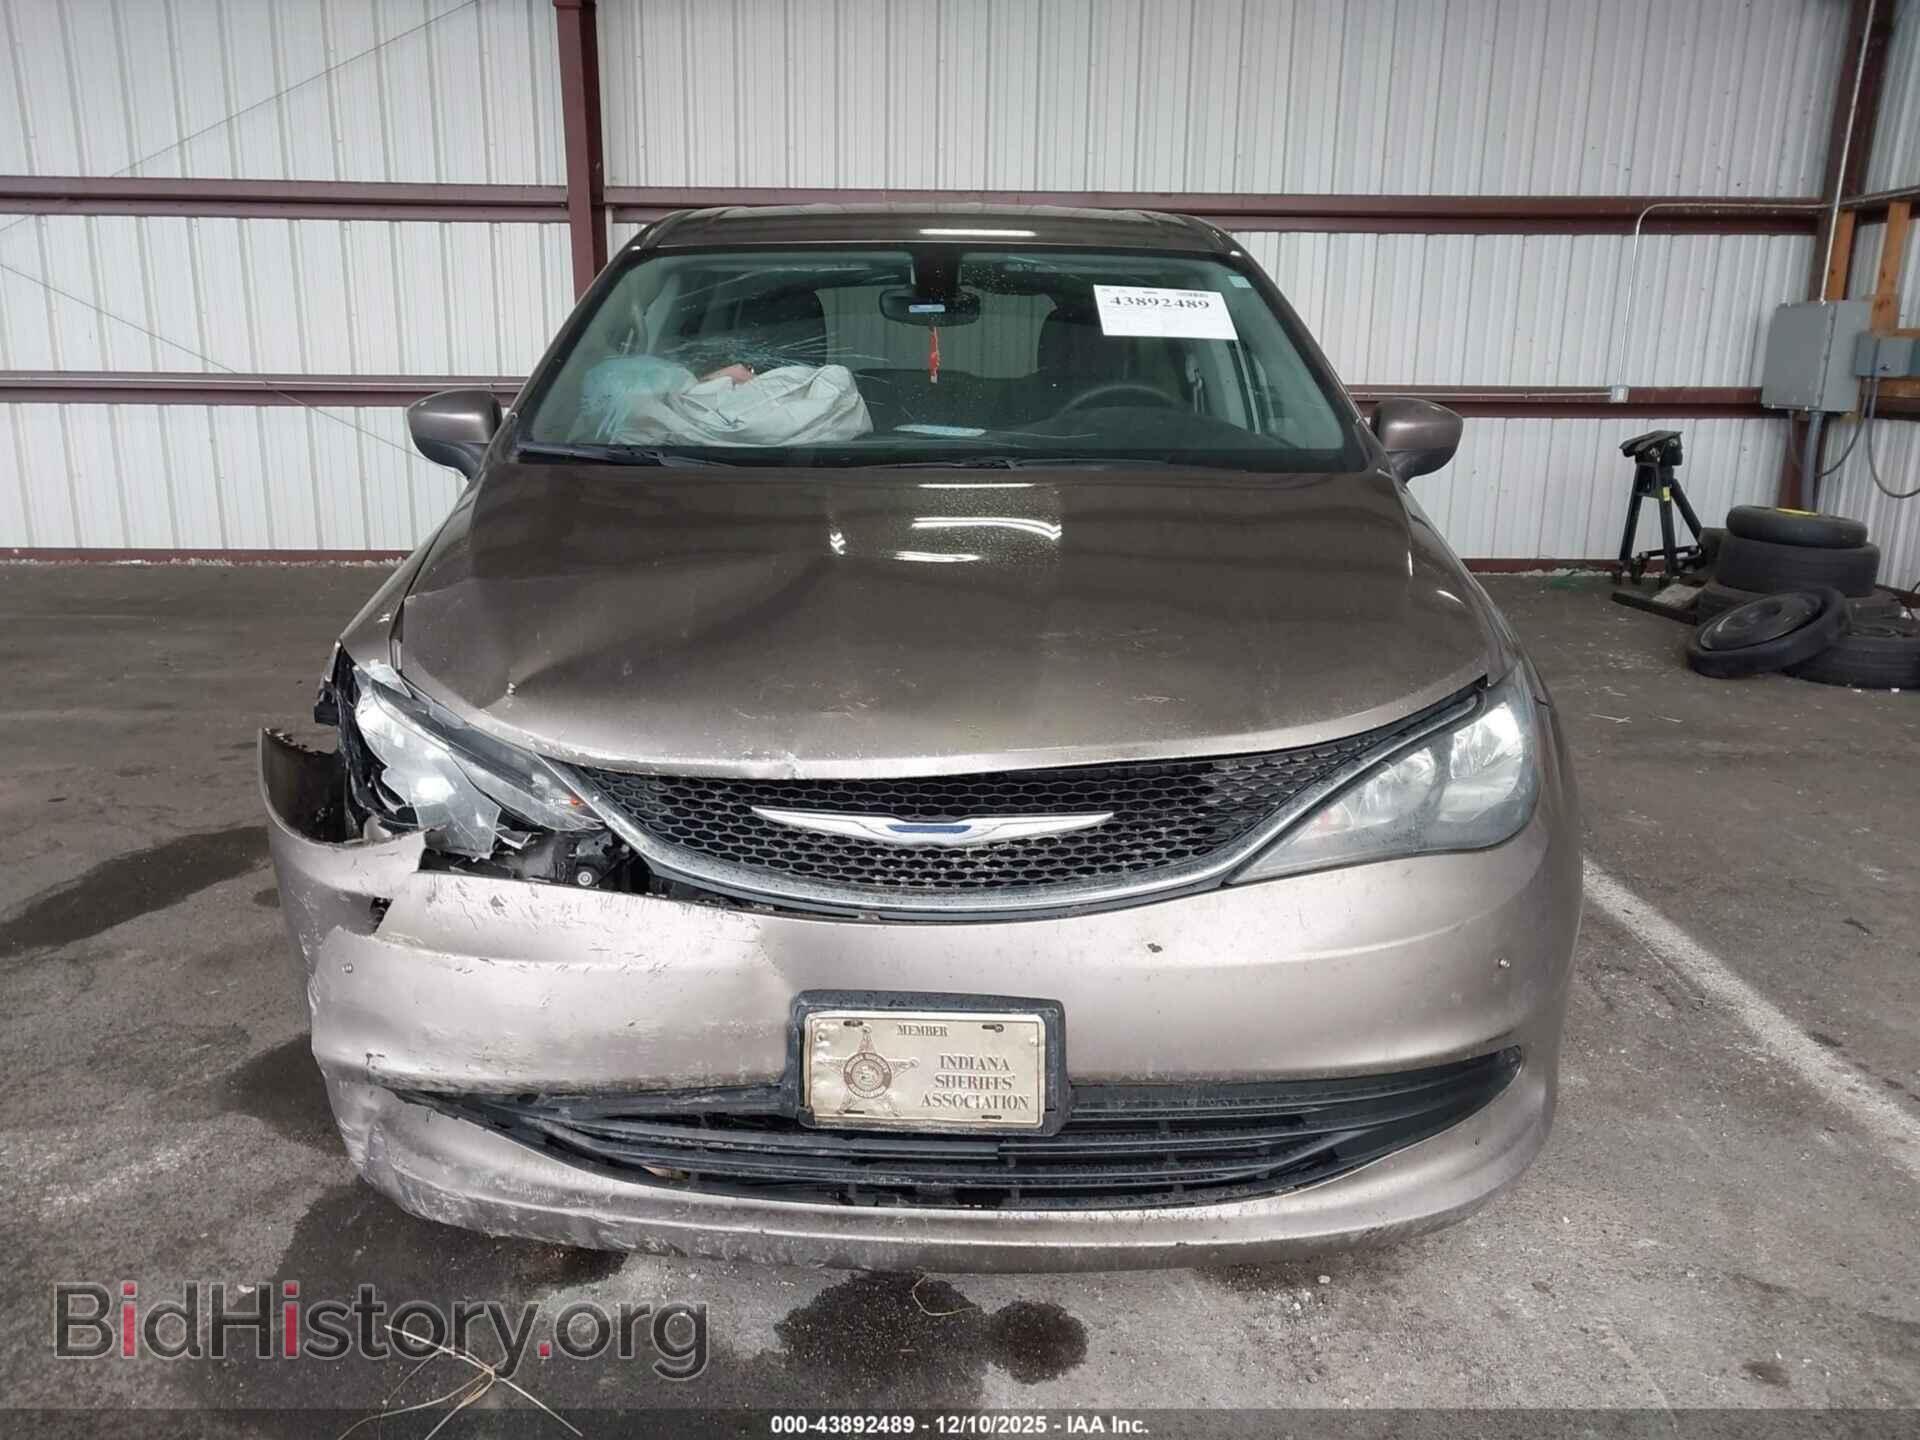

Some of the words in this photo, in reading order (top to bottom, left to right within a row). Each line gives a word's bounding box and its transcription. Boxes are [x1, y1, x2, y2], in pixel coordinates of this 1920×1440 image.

[1109, 296, 1210, 309] 43892489
[896, 1024, 949, 1038] MEMBER
[939, 1054, 1011, 1072] INDIANA
[920, 1093, 1030, 1111] ASSOCIATION
